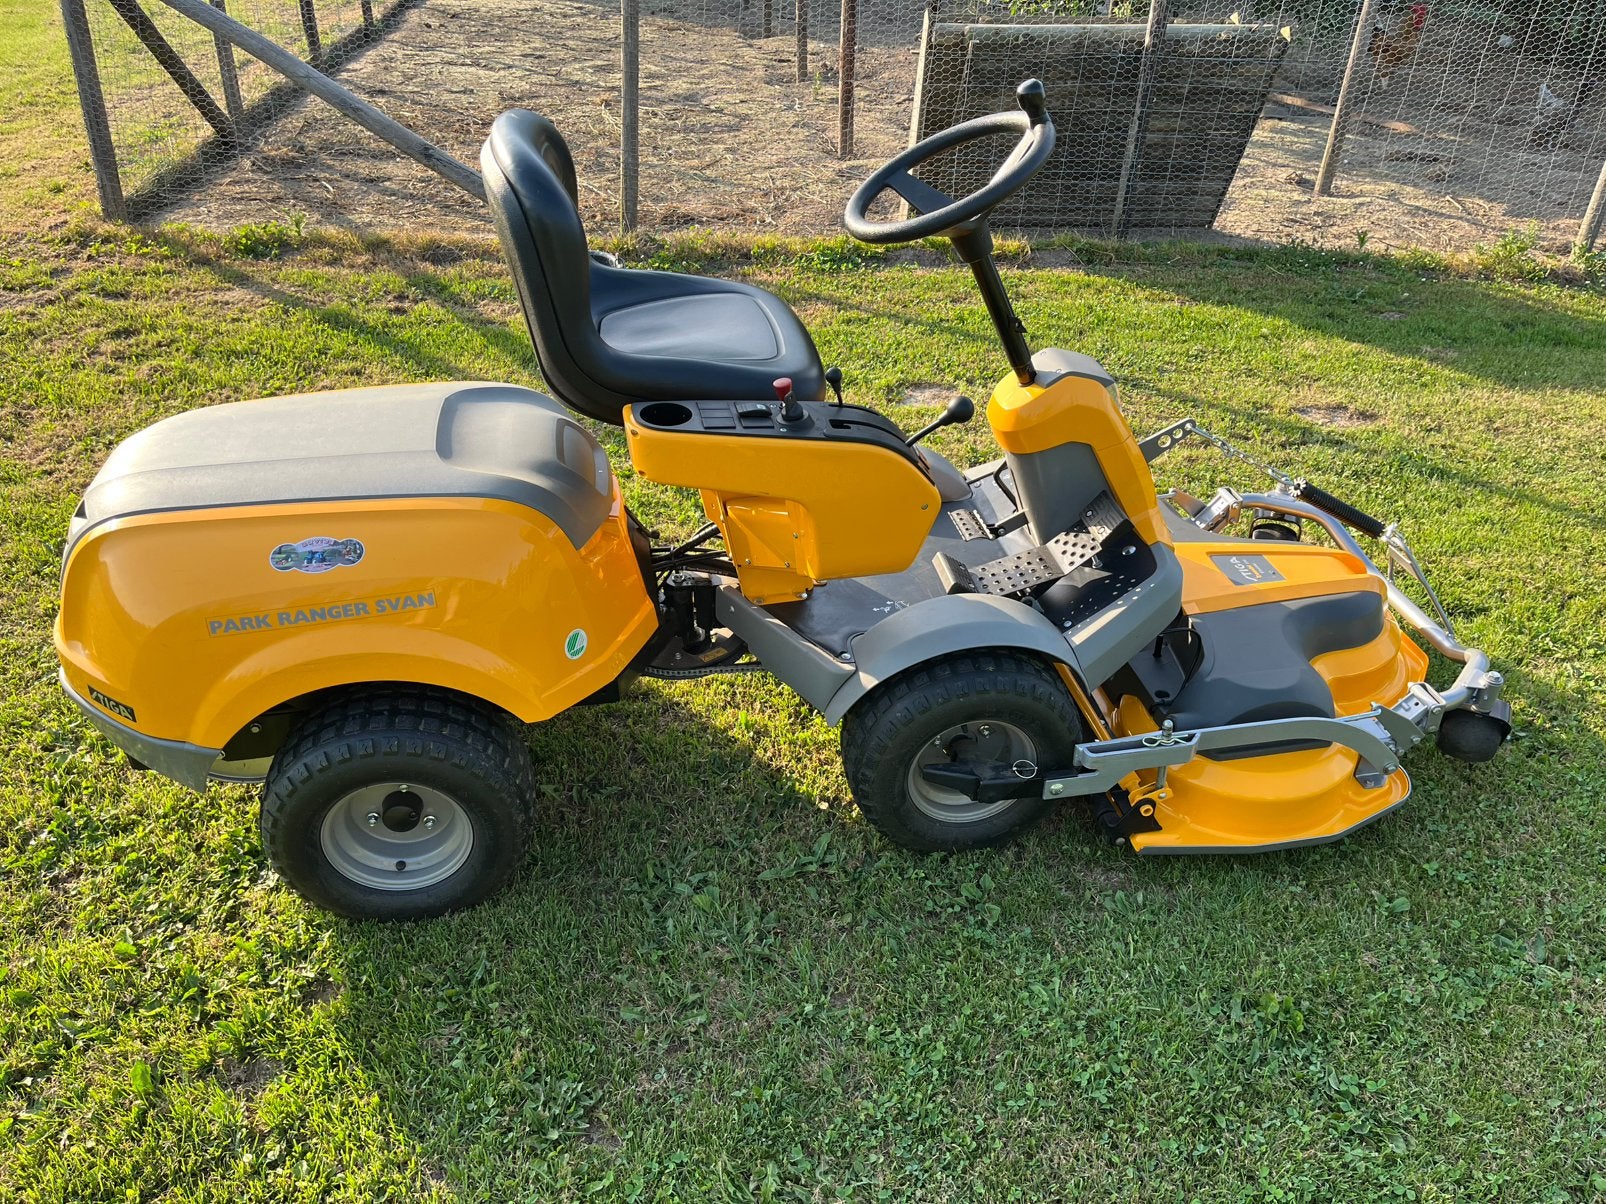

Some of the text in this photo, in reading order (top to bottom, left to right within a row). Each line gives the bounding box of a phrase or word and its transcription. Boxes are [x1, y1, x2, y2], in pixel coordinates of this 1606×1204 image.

[209, 592, 435, 635] PARK RANGER SVAN
[92, 691, 133, 720] STIGA
